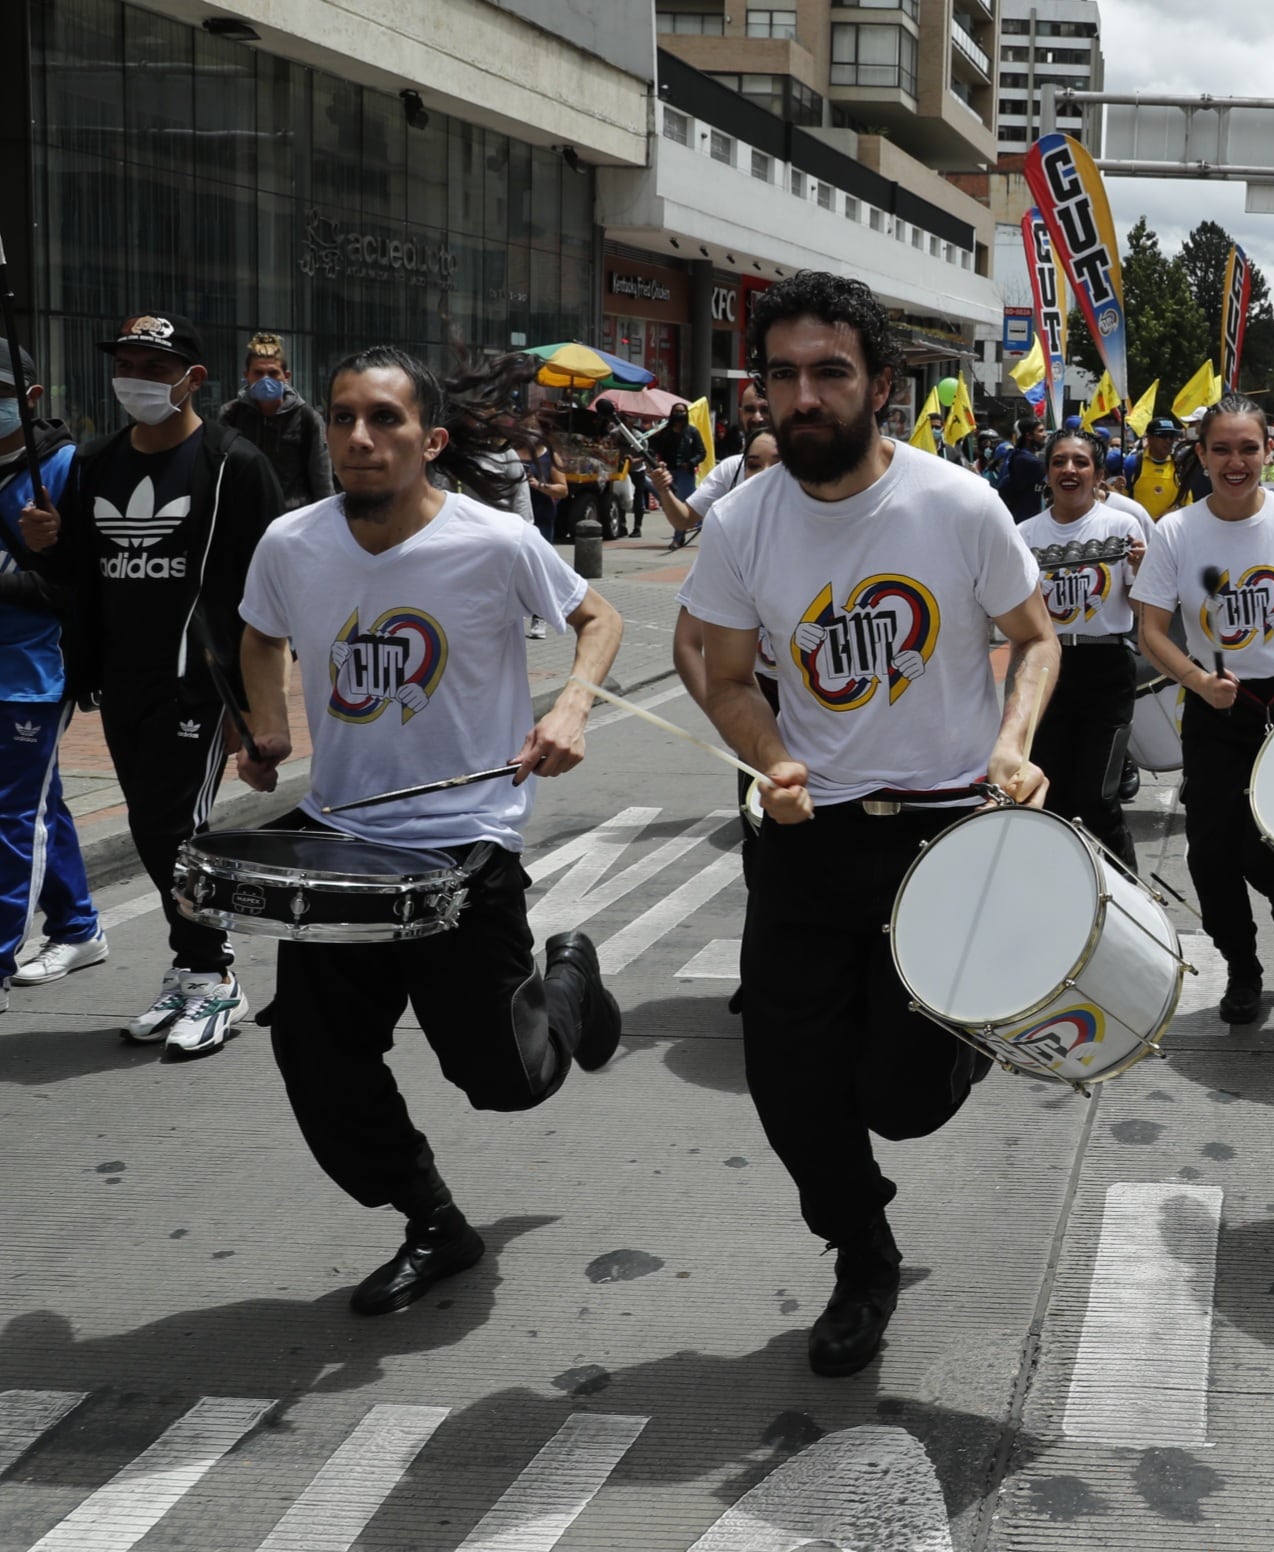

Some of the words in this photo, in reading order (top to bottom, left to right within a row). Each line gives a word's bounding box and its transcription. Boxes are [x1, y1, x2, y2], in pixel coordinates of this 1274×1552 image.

[1041, 144, 1117, 307] CUT
[1032, 220, 1062, 356] CUT
[100, 551, 187, 579] adidas
[1052, 574, 1091, 609] CUT
[1222, 587, 1270, 630] CUT
[346, 633, 410, 698] CUT
[822, 610, 898, 680] CUT
